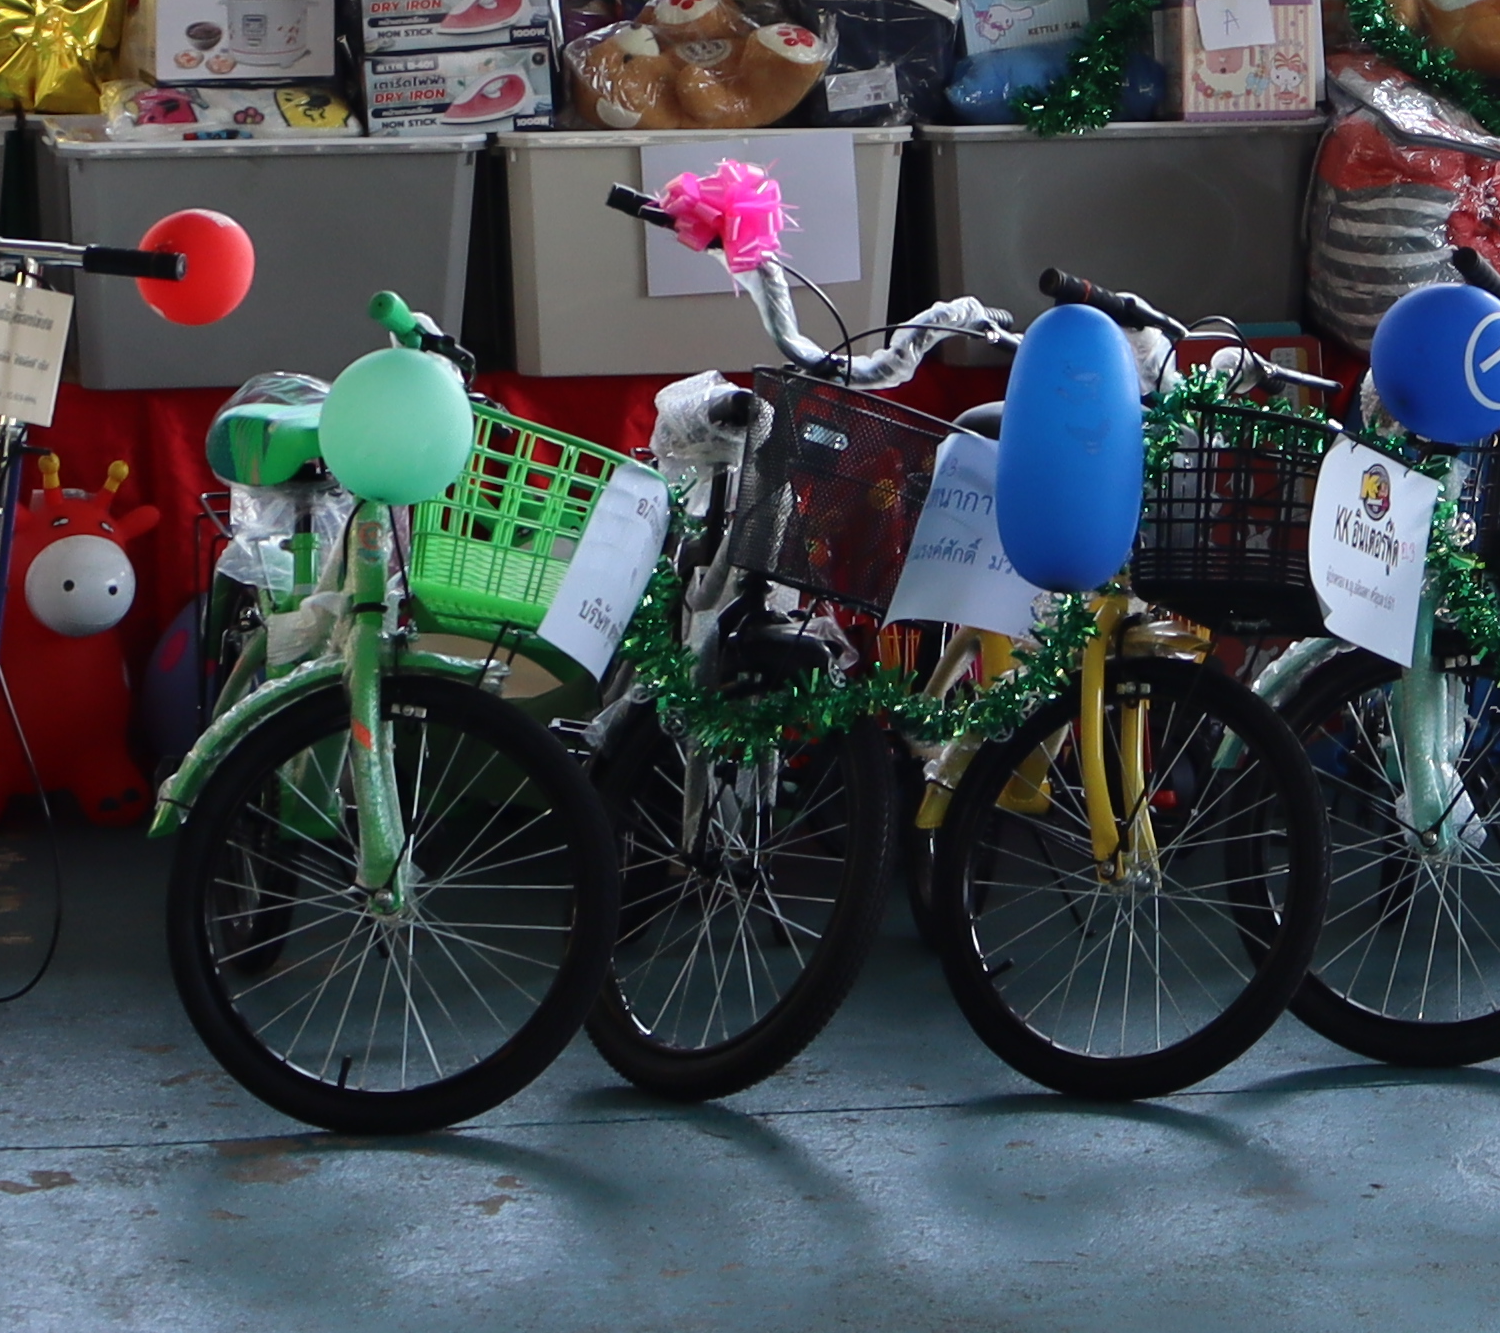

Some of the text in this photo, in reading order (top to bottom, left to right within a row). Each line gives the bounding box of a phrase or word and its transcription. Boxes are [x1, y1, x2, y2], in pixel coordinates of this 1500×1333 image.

[370, 0, 442, 13] DRY IRON
[1223, 9, 1240, 35] A
[377, 28, 434, 39] NON STICK
[374, 89, 446, 104] DRY IRON
[381, 118, 438, 129] NON STICK
[1333, 504, 1353, 546] KK
